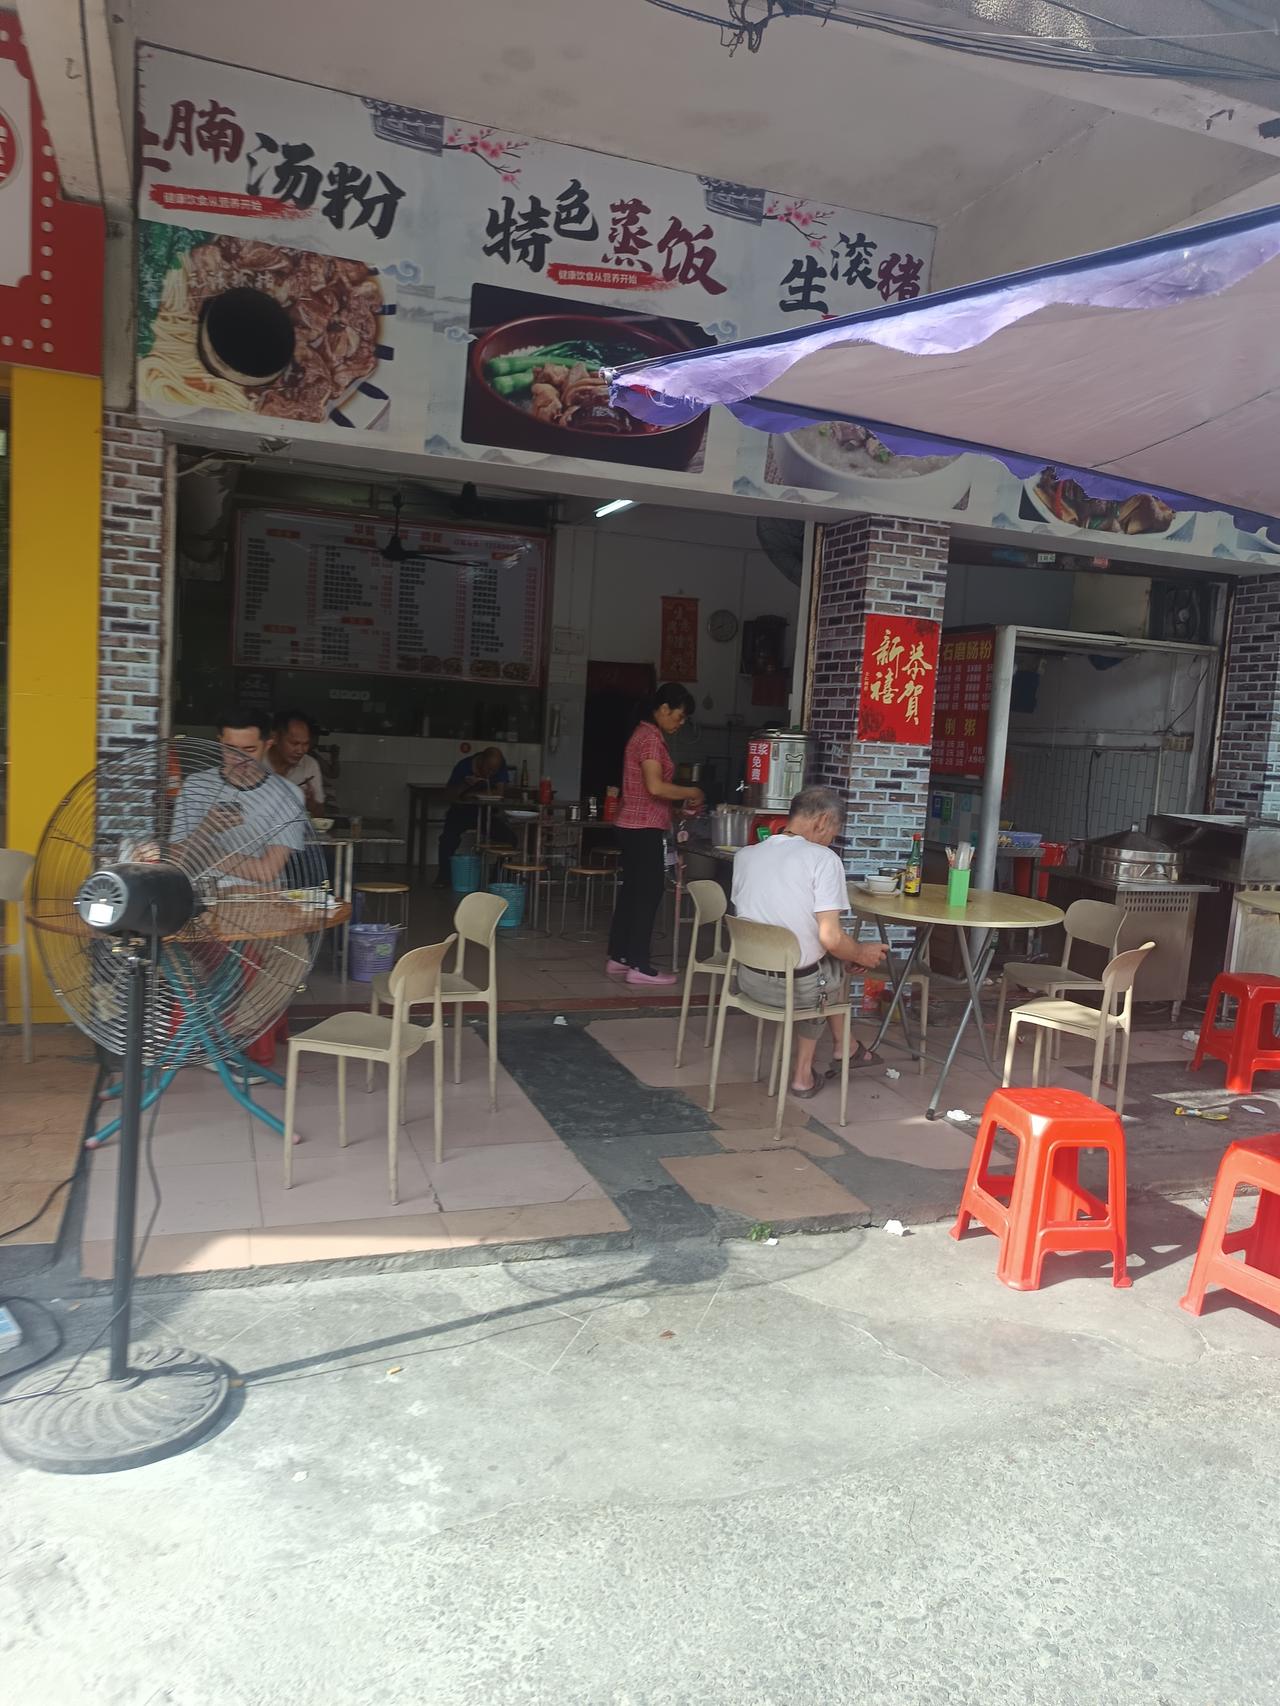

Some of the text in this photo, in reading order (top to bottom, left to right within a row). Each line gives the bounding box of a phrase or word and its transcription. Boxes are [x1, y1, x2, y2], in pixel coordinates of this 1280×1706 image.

[482, 179, 728, 295] 特色蒸饭
[779, 232, 924, 314] 生滚猪
